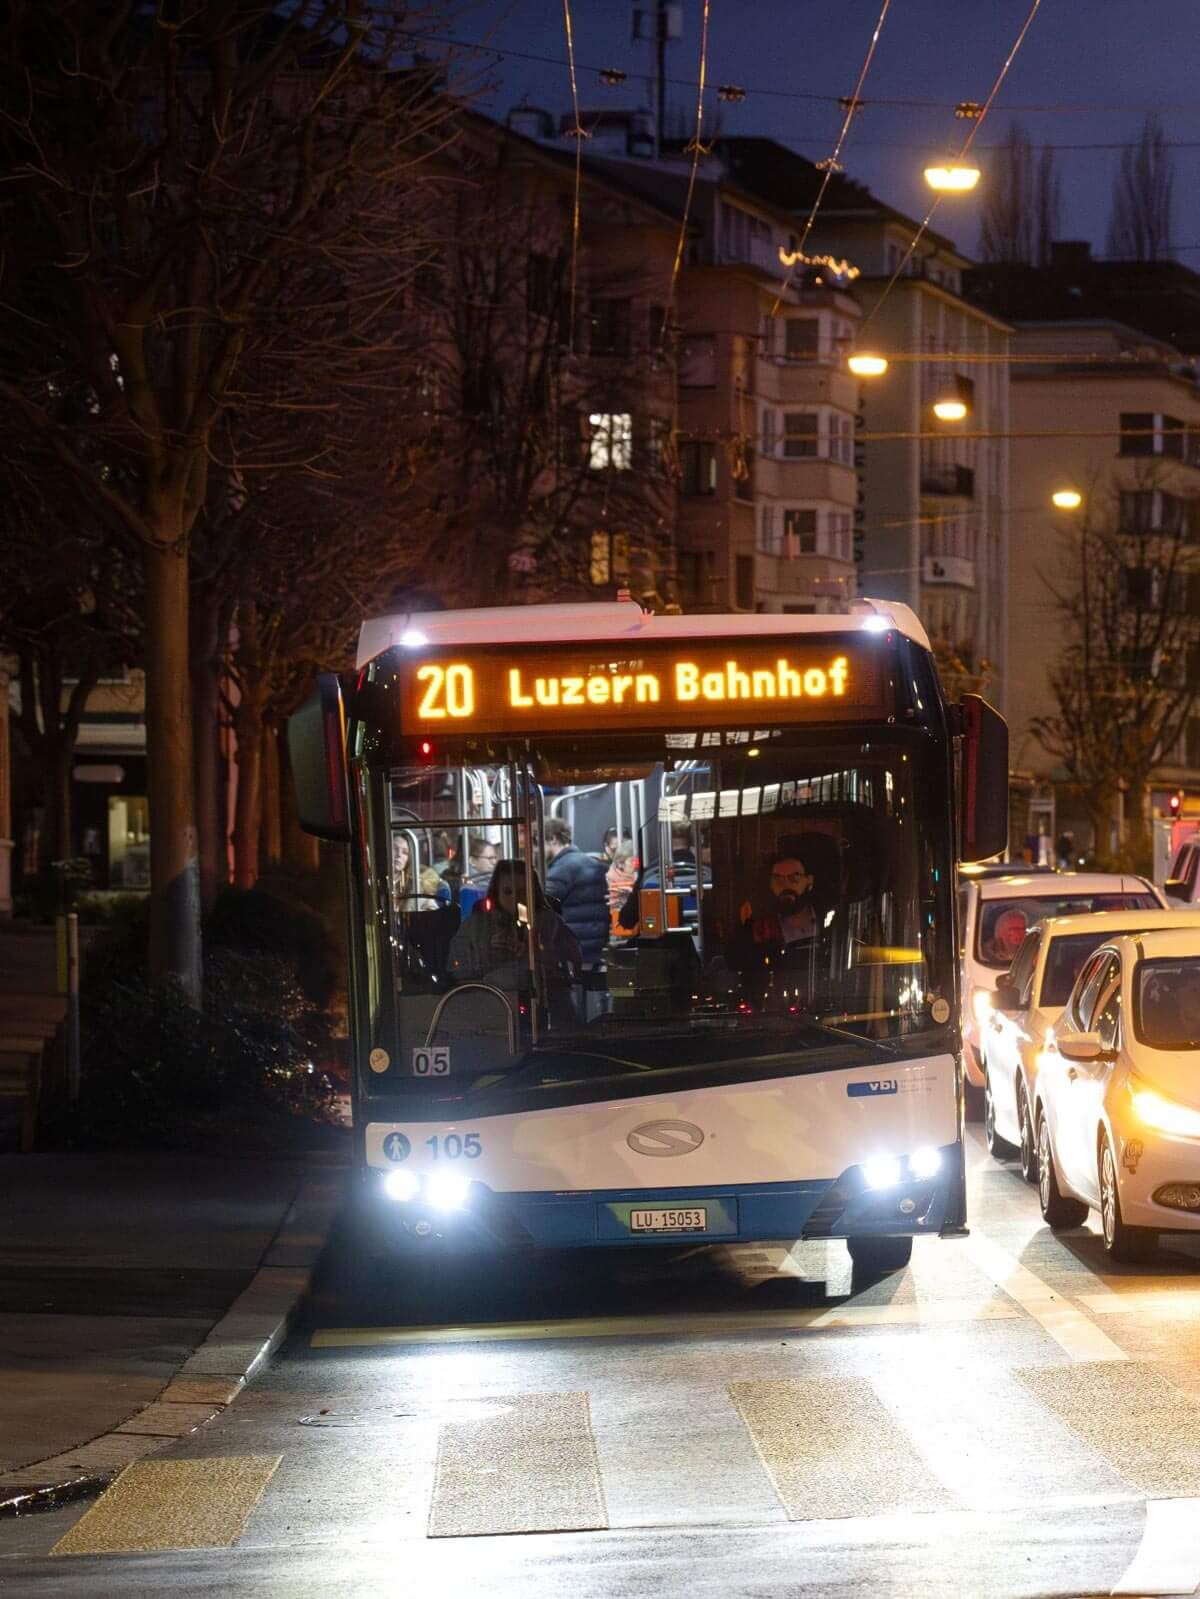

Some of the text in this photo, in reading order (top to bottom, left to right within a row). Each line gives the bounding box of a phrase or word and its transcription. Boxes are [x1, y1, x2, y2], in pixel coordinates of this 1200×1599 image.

[417, 657, 847, 718] 20 Luzern Bahnhof
[415, 1053, 448, 1074] 05
[425, 1133, 482, 1161] 105
